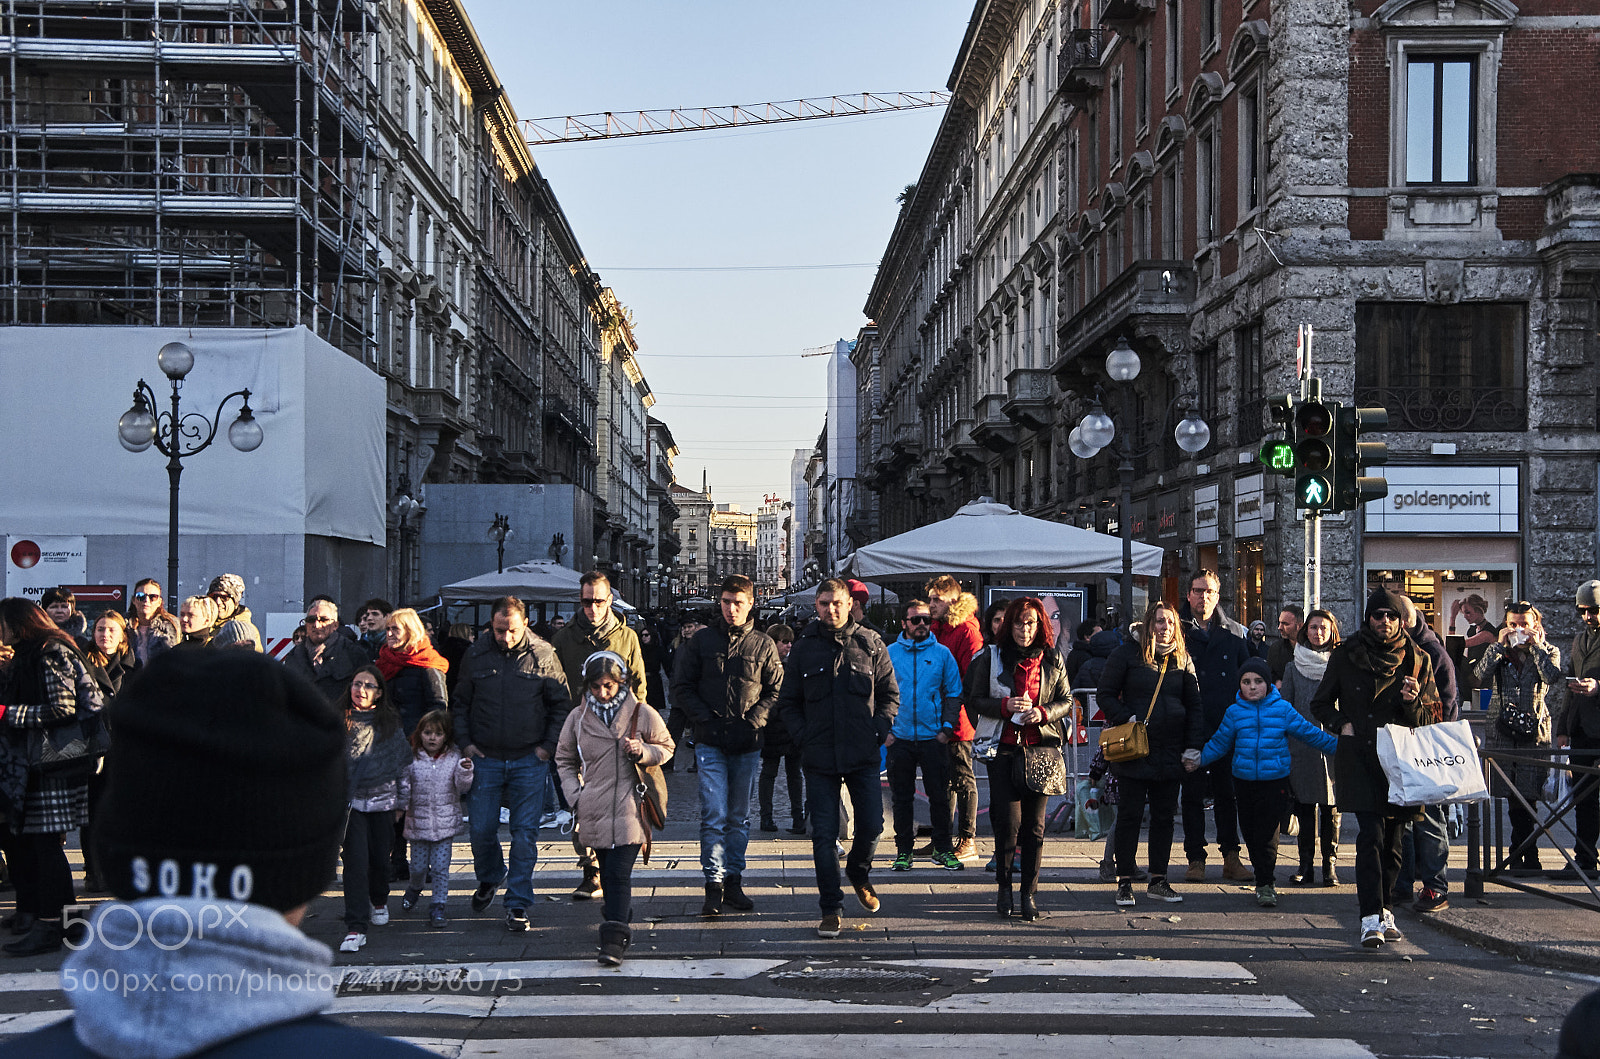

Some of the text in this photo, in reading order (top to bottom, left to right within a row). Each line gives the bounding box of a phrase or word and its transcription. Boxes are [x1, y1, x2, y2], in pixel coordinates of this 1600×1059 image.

[1272, 445, 1294, 469] 20
[1393, 490, 1491, 510] goldenpoint
[1414, 755, 1466, 768] MANGO
